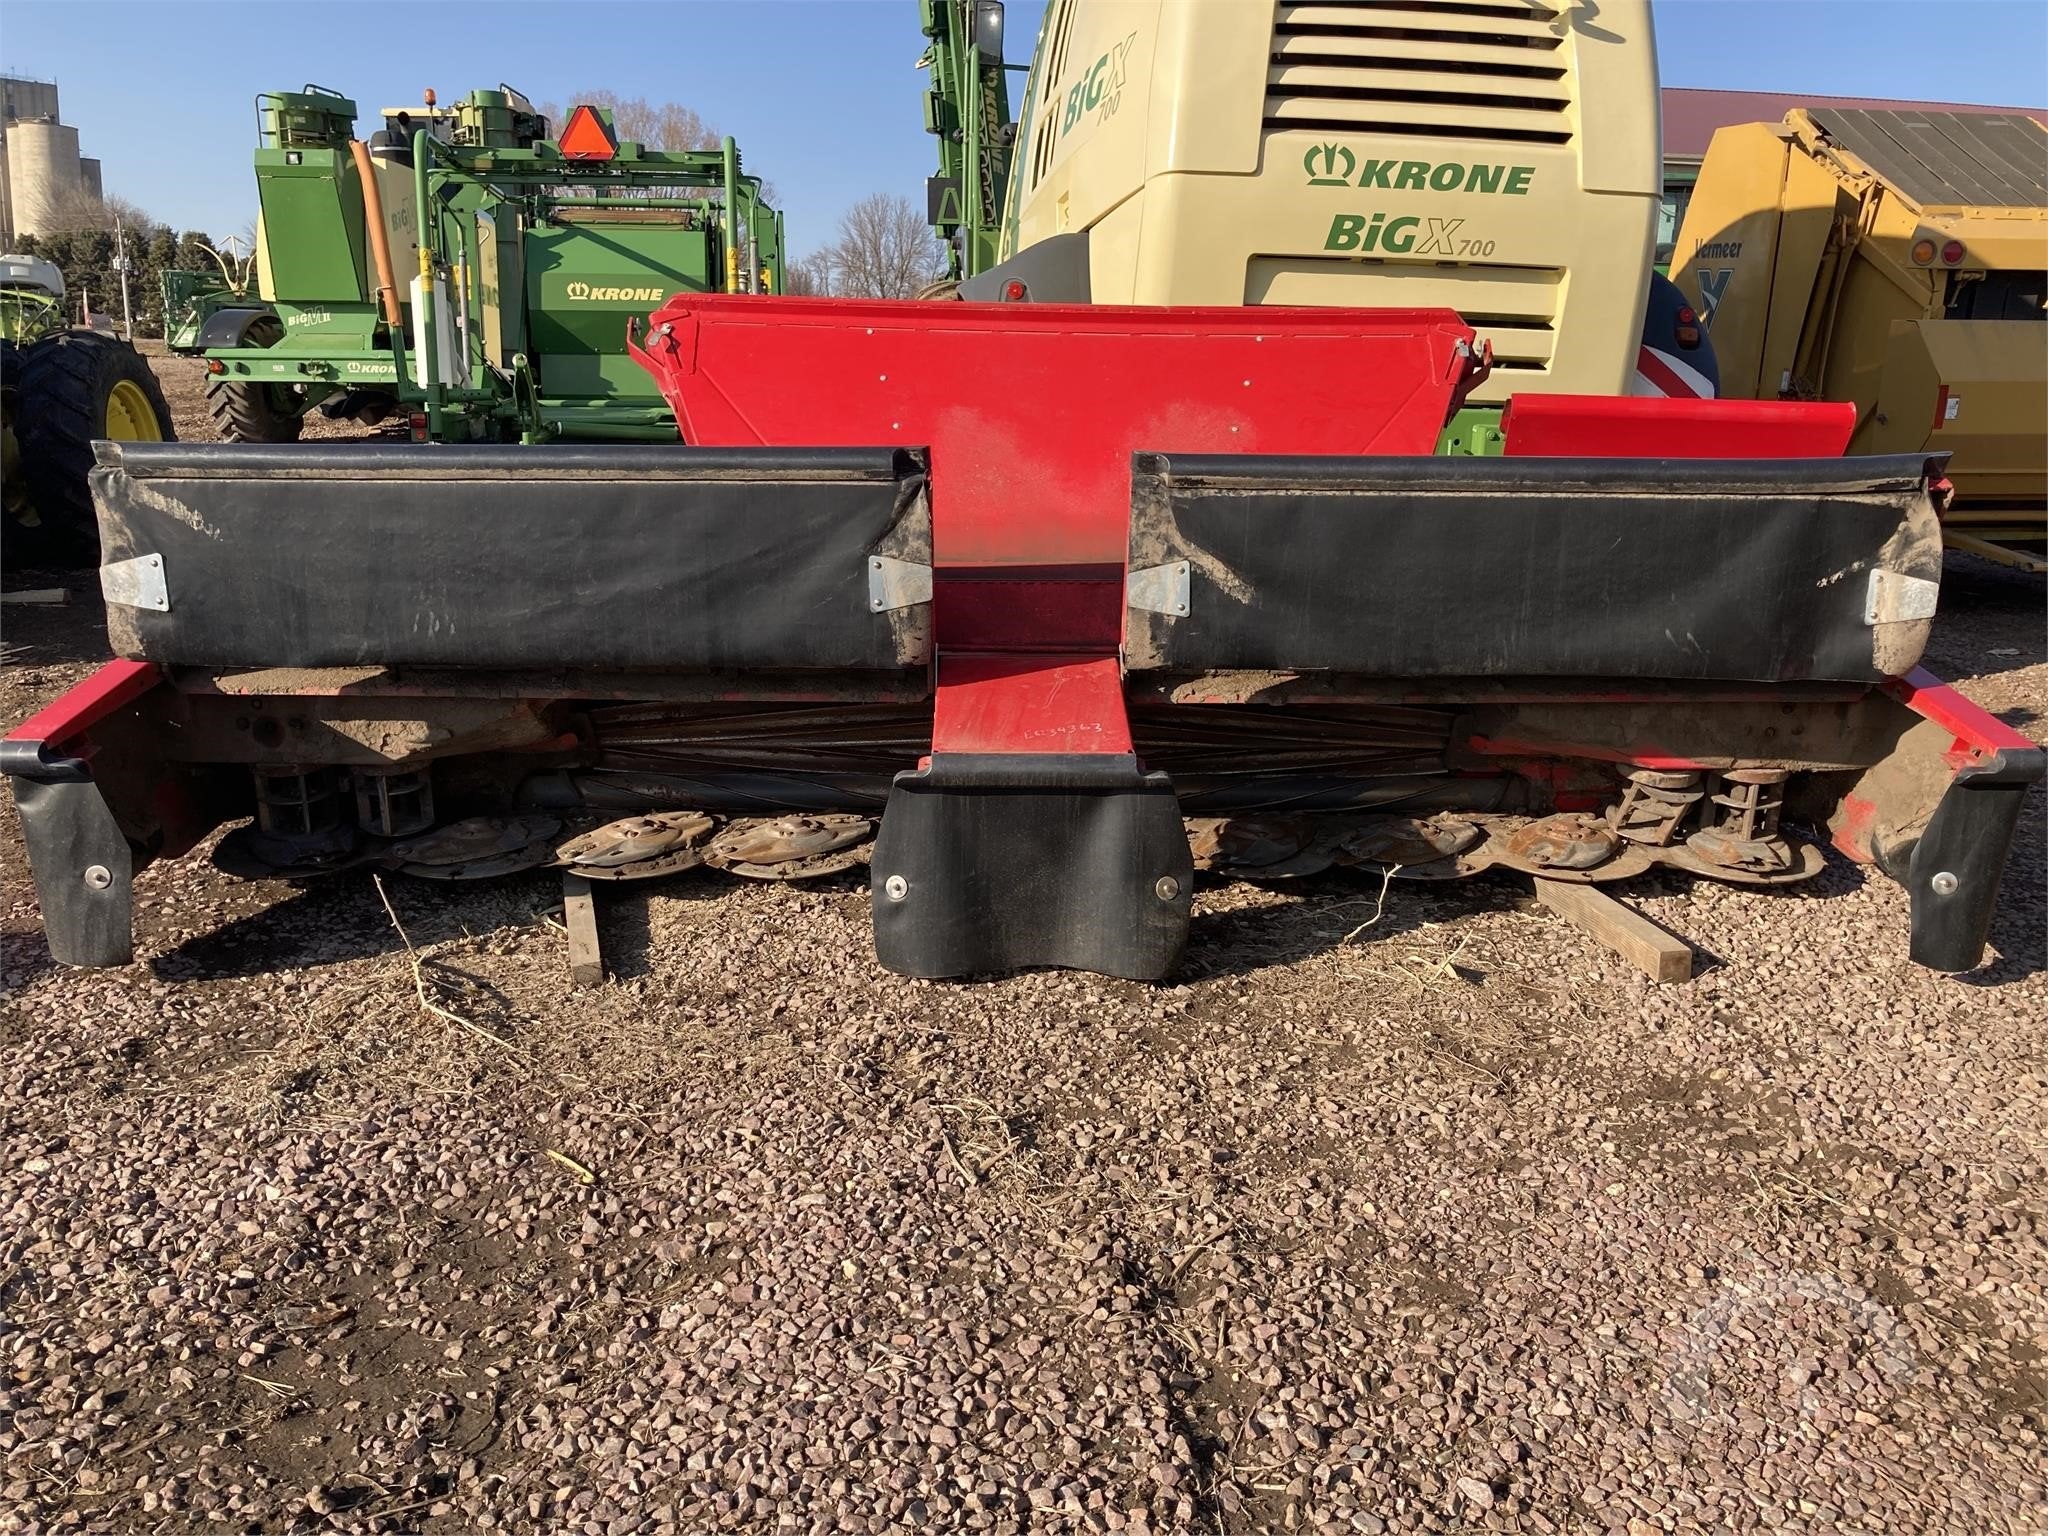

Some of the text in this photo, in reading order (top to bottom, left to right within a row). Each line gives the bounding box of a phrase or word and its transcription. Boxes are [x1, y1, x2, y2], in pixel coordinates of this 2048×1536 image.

[1096, 90, 1120, 127] 700
[984, 87, 1004, 176] KRONE
[1358, 159, 1536, 195] KRONE
[1458, 239, 1496, 257] 700
[1695, 238, 1742, 258] Vermeer
[590, 287, 664, 301] KRONE
[361, 364, 397, 373] KRON
